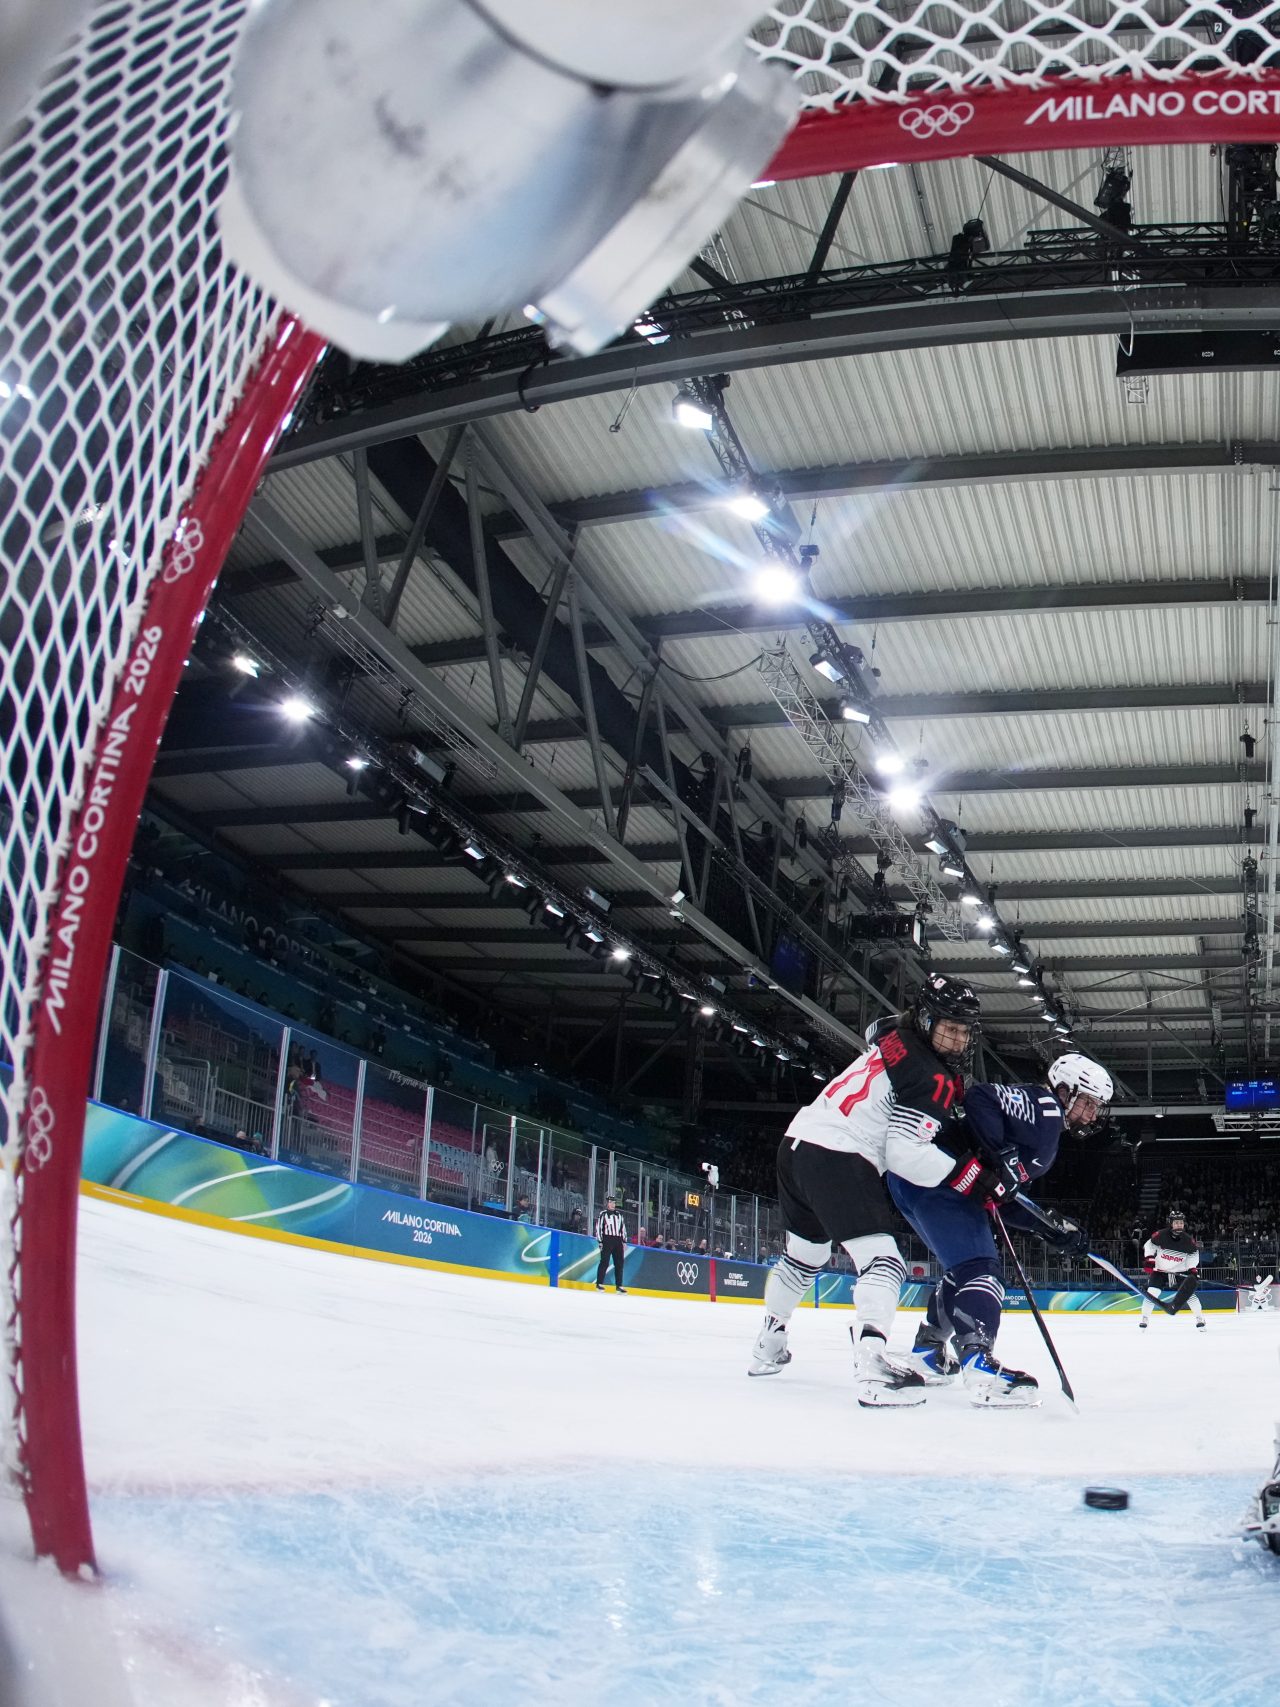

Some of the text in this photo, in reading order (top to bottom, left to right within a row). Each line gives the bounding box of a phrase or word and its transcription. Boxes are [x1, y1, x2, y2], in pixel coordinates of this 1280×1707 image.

[1024, 91, 1186, 125] MILANO
[45, 625, 163, 1035] MILANO CORTINA 2026
[932, 1073, 954, 1110] 11
[953, 1162, 980, 1192] RRIOR
[382, 1210, 462, 1237] MILANO CORTINA
[413, 1230, 432, 1244] 2026
[1160, 1254, 1184, 1262] JAPAN
